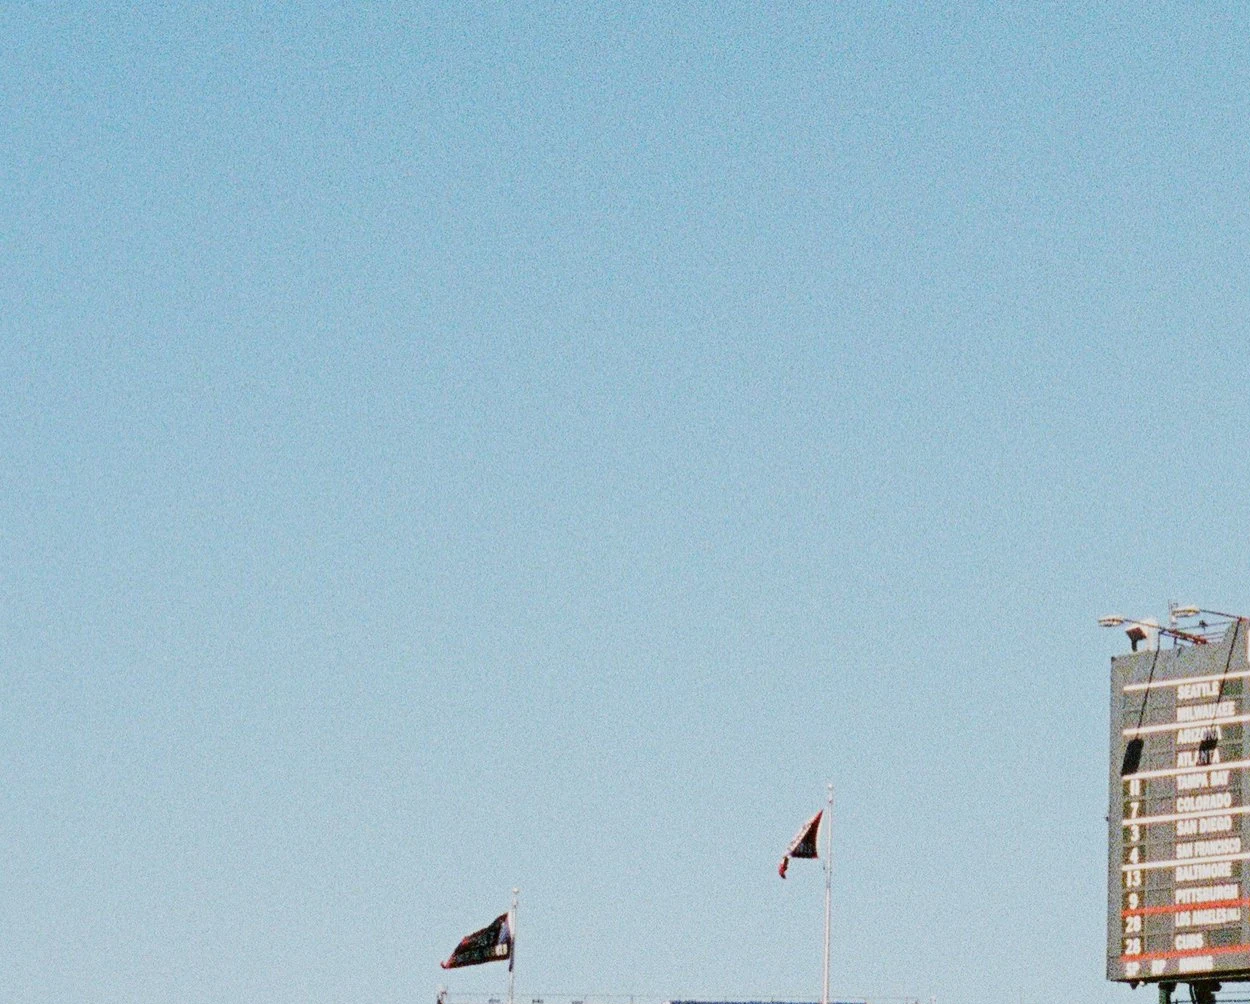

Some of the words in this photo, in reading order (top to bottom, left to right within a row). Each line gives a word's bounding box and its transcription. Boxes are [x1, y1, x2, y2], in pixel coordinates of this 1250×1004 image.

[1177, 680, 1220, 700] SEATTLE
[1176, 701, 1235, 722] MILWAUKEE
[1209, 770, 1231, 786] BAY
[1176, 792, 1232, 812] COLORADO
[1176, 819, 1198, 836] SAN
[1199, 815, 1232, 834] DIEGO
[1126, 870, 1141, 888] 13
[1176, 862, 1232, 882] BALTIMORE
